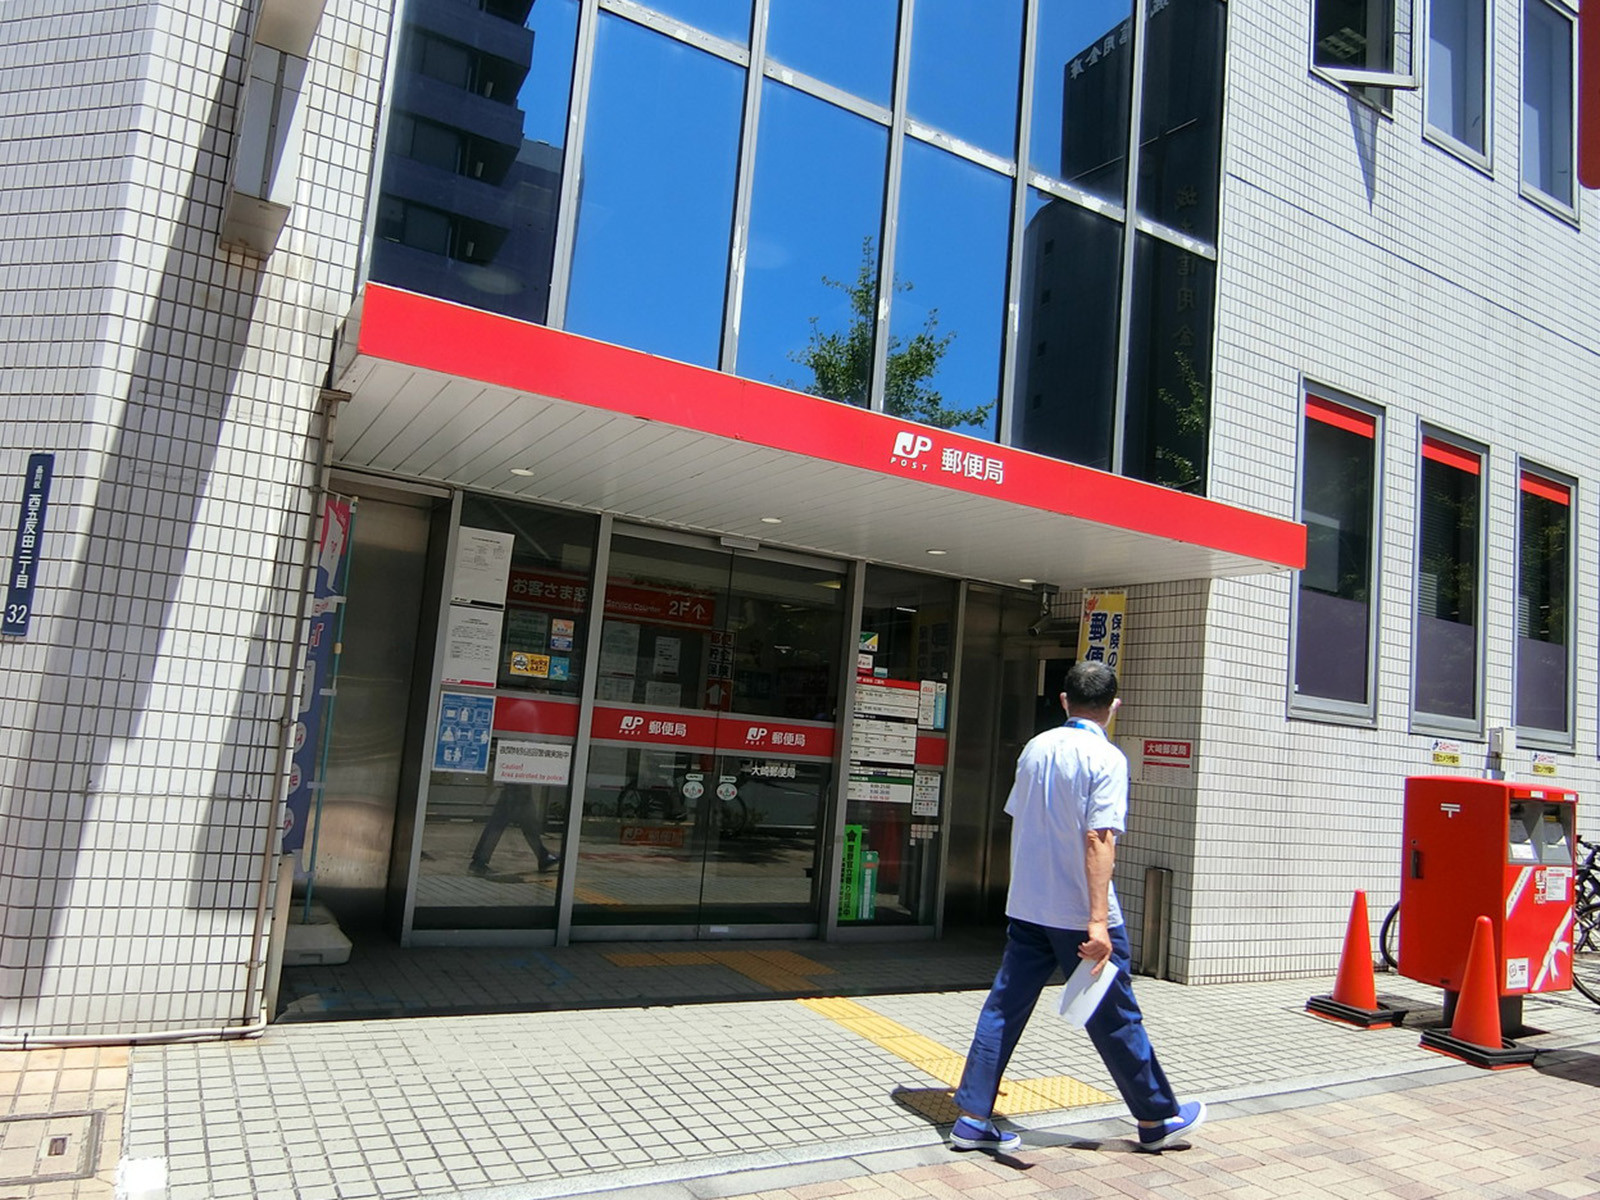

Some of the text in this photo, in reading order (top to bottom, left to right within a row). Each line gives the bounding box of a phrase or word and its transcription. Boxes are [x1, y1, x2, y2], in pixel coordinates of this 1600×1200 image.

[893, 431, 932, 459] JP
[890, 457, 927, 471] POST
[941, 447, 1004, 484] 郵便局
[33, 465, 44, 489] 品川区
[15, 494, 42, 589] 西五反田二丁目
[6, 604, 28, 624] 32
[669, 600, 690, 616] 2F
[1085, 612, 1108, 662] 郵便
[1107, 613, 1123, 669] 保険の
[619, 715, 644, 730] JP
[648, 720, 687, 738] 郵便局
[746, 726, 768, 741] JP
[772, 731, 806, 748] 郵便局
[1146, 744, 1187, 756] 大崎郵便局
[751, 765, 796, 779] 大崎郵便局
